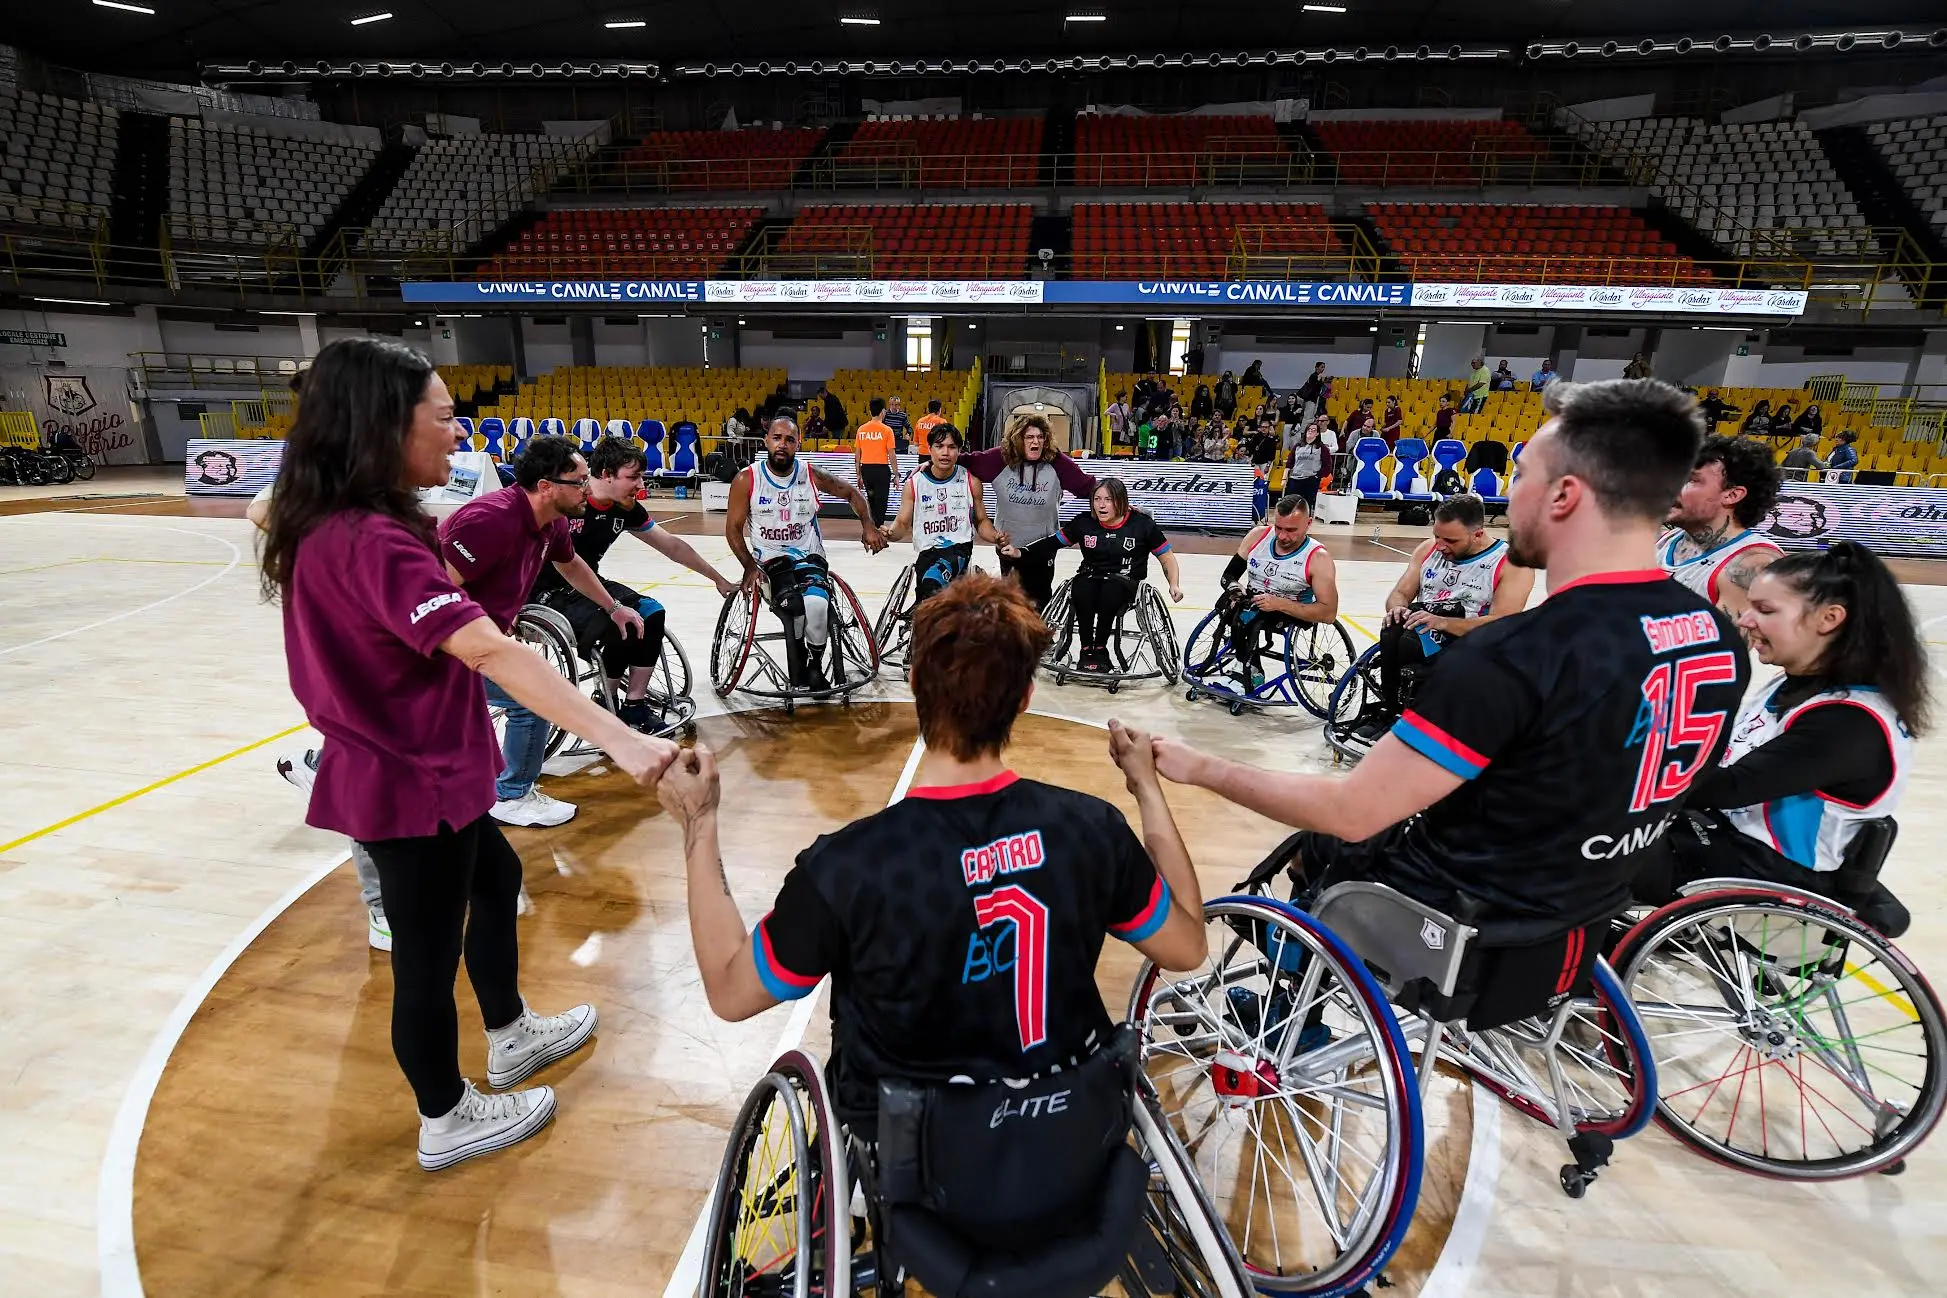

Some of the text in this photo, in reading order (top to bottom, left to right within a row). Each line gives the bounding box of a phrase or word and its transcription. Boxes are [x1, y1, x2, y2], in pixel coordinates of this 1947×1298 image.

[551, 283, 621, 299] CANALE
[626, 283, 698, 299] CANALE
[1226, 284, 1312, 302] CANALE
[1317, 284, 1405, 303] CANALE
[859, 432, 883, 440] ITALIA
[1008, 493, 1046, 506] Calabria
[452, 540, 476, 563] LEGEA
[409, 592, 462, 625] LEGEA
[1628, 652, 1736, 813] 15
[961, 829, 1046, 886] CASTRO
[973, 884, 1049, 1053] 7
[989, 1089, 1072, 1129] ELITE
